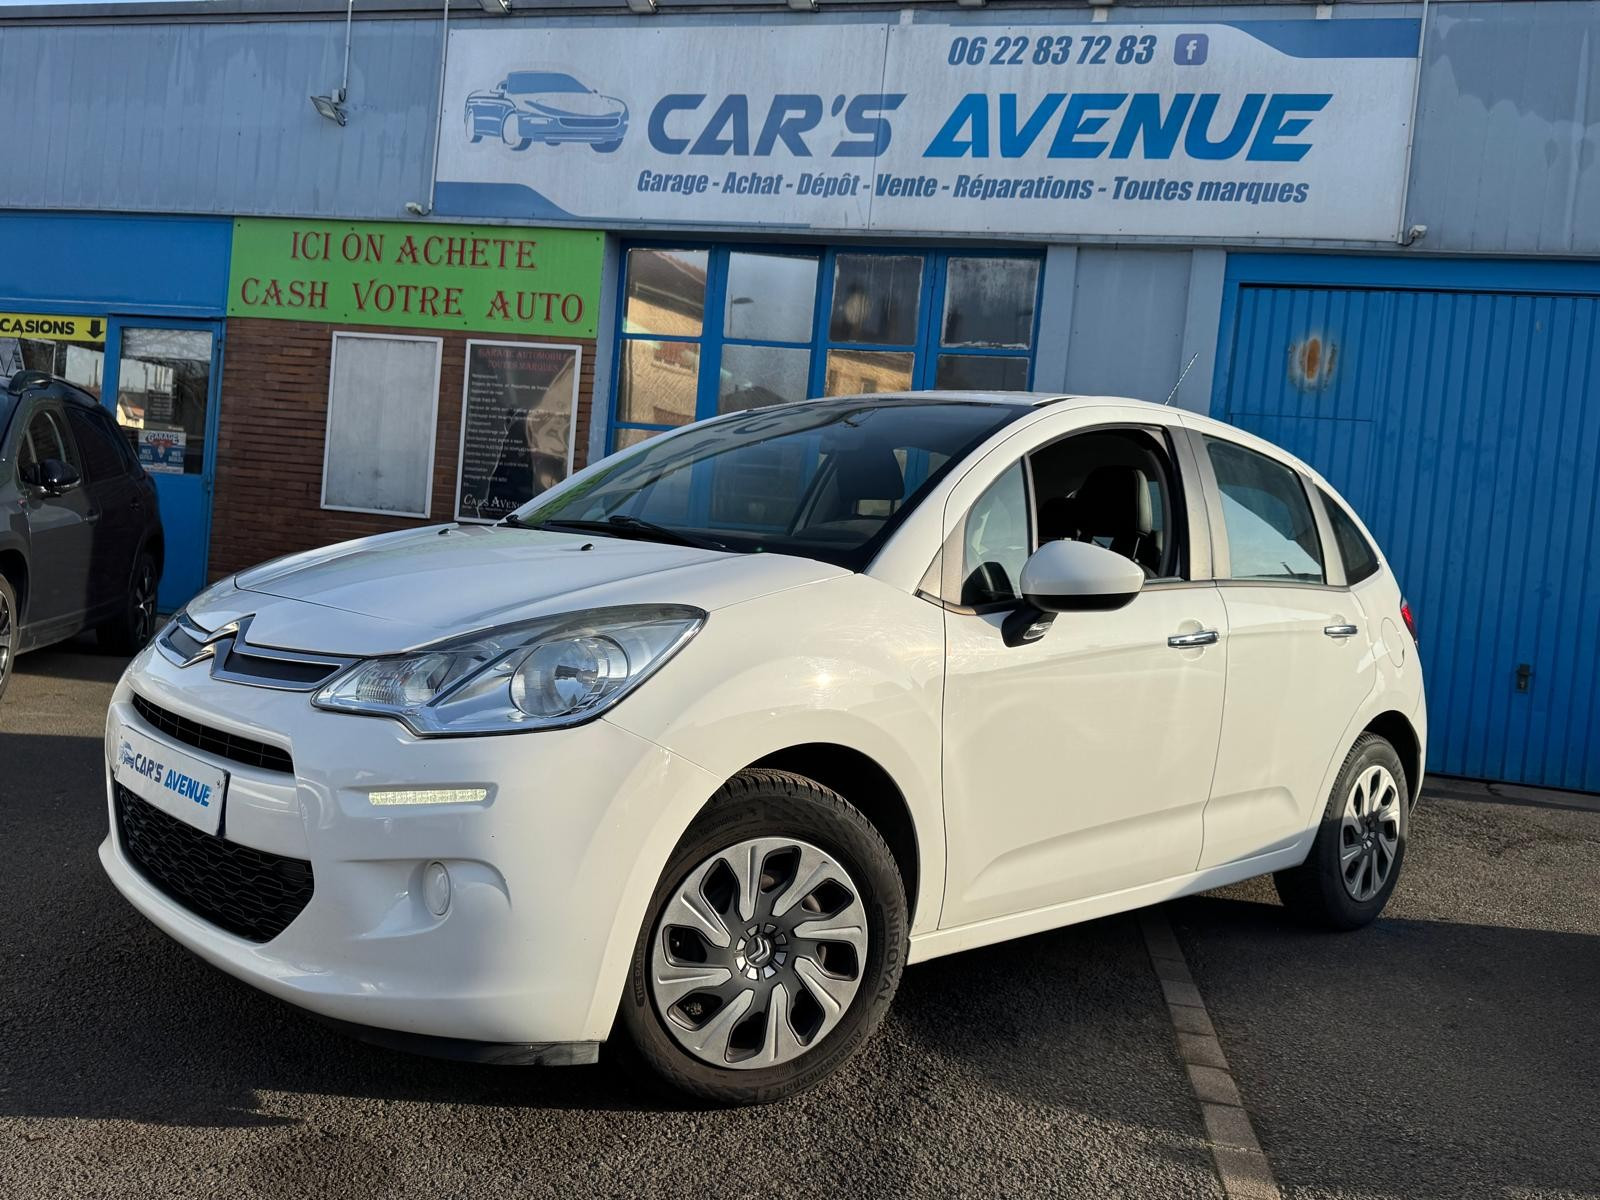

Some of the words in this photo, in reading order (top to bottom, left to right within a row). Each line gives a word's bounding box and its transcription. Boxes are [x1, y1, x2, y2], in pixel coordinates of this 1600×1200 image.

[948, 37, 987, 66] 06
[989, 36, 1031, 65] 22
[1033, 36, 1072, 65] 83
[1076, 35, 1112, 65] 72
[1115, 35, 1157, 65] 83
[647, 93, 907, 158] CAR'S
[922, 93, 1333, 162] AVENUE
[637, 170, 711, 195] Garage
[722, 172, 783, 195] Achat
[796, 173, 859, 198] Dépôt
[874, 174, 937, 197] Vente
[953, 174, 1094, 201] Réparations
[1112, 176, 1192, 201] Toutes
[1196, 179, 1309, 204] marques
[291, 231, 332, 261] ICI
[341, 233, 384, 263] ON
[395, 235, 538, 270] ACHETE
[241, 277, 329, 309] CASH
[352, 279, 464, 318] VOTRE
[486, 290, 585, 324] AUTO
[134, 753, 164, 783] CAR'S
[163, 769, 213, 807] AVENUE
[872, 893, 901, 1006] UNIROYAL
